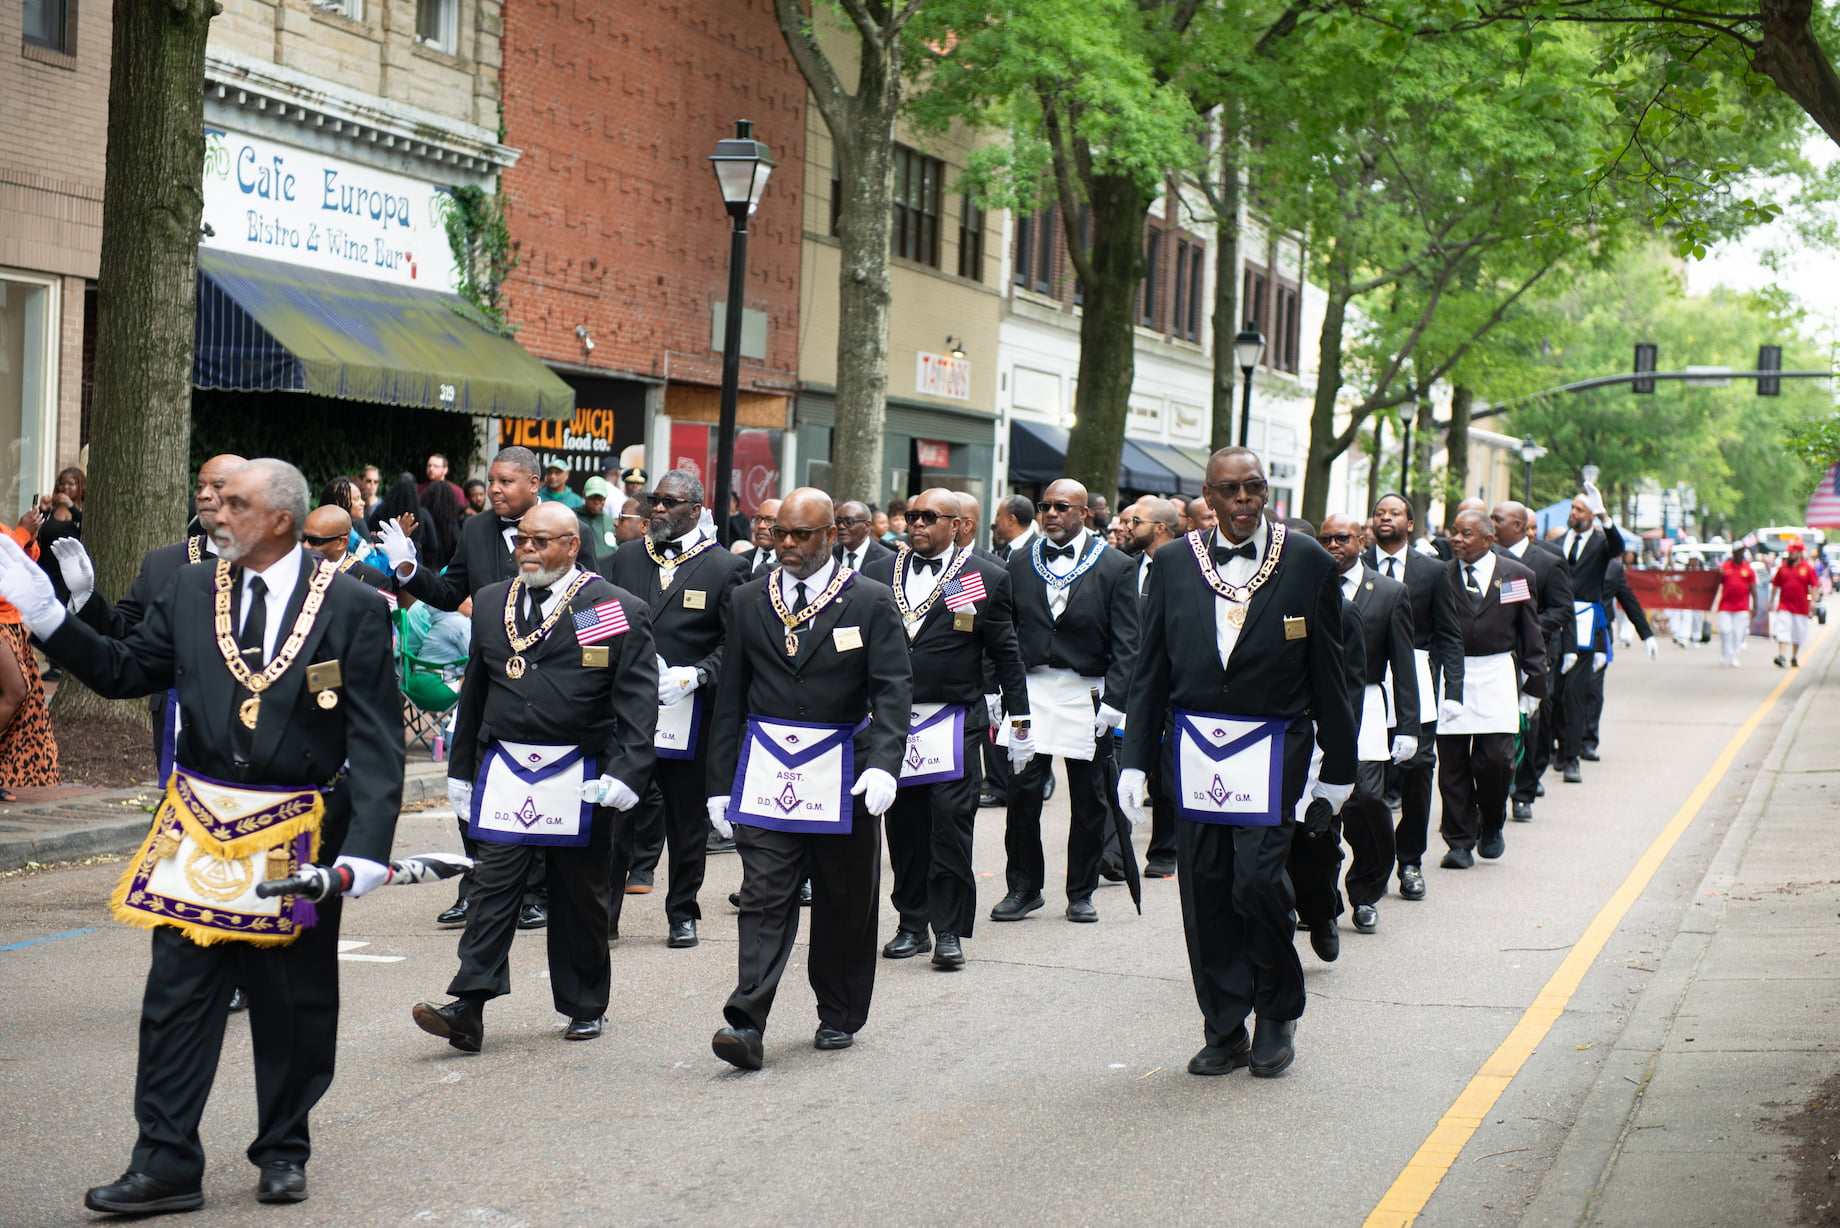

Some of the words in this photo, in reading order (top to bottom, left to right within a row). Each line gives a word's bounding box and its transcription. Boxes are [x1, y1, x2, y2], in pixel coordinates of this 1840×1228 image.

[237, 145, 296, 201] Cafe
[321, 168, 411, 230] Europa
[247, 209, 300, 249] Bistro
[306, 222, 321, 252] &
[327, 227, 369, 265] Wine
[374, 236, 404, 271] Bar
[439, 384, 456, 402] 319
[563, 427, 592, 451] food
[906, 735, 922, 744] SST.
[776, 771, 805, 782] ASST.
[757, 796, 773, 807] D.D.
[805, 802, 824, 811] G.M.
[1235, 793, 1252, 802] G.M.
[494, 811, 512, 822] D.D.
[545, 816, 564, 825] G.M.
